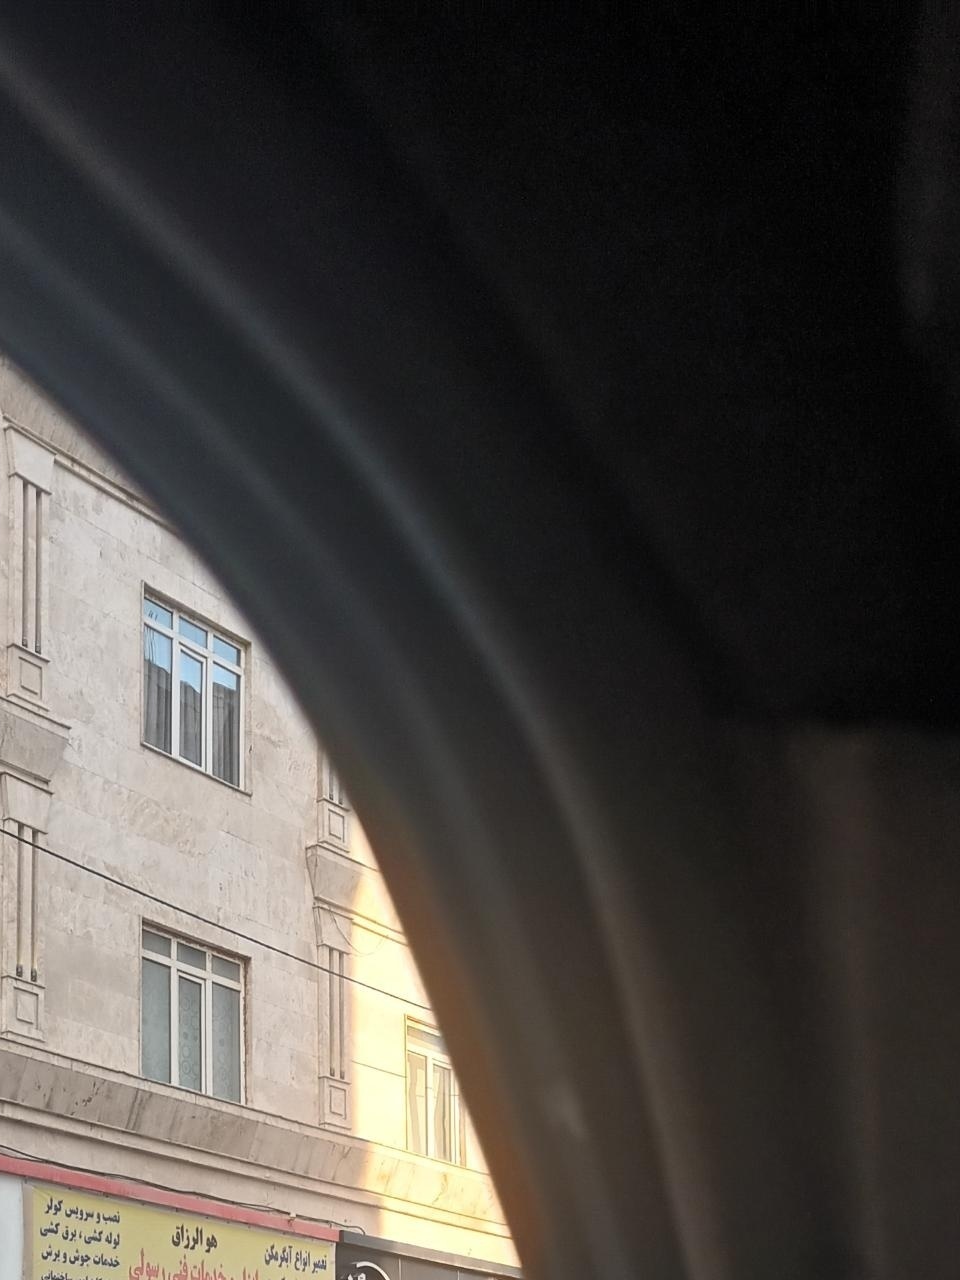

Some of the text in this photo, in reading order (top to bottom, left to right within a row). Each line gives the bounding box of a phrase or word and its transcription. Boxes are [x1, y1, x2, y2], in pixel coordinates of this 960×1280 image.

[44, 1196, 63, 1216] کولر
[65, 1206, 94, 1222] سرویس
[102, 1210, 121, 1225] نصب
[40, 1221, 60, 1237] کشی
[61, 1225, 77, 1242] برق
[84, 1228, 103, 1245] کشی
[171, 1223, 218, 1253] هو الرزاق
[104, 1231, 121, 1249] لوله
[41, 1243, 60, 1262] برش
[68, 1248, 91, 1267] جوش
[92, 1253, 121, 1268] خدمات
[294, 1249, 311, 1272] انواع
[311, 1254, 327, 1274] تعمیر
